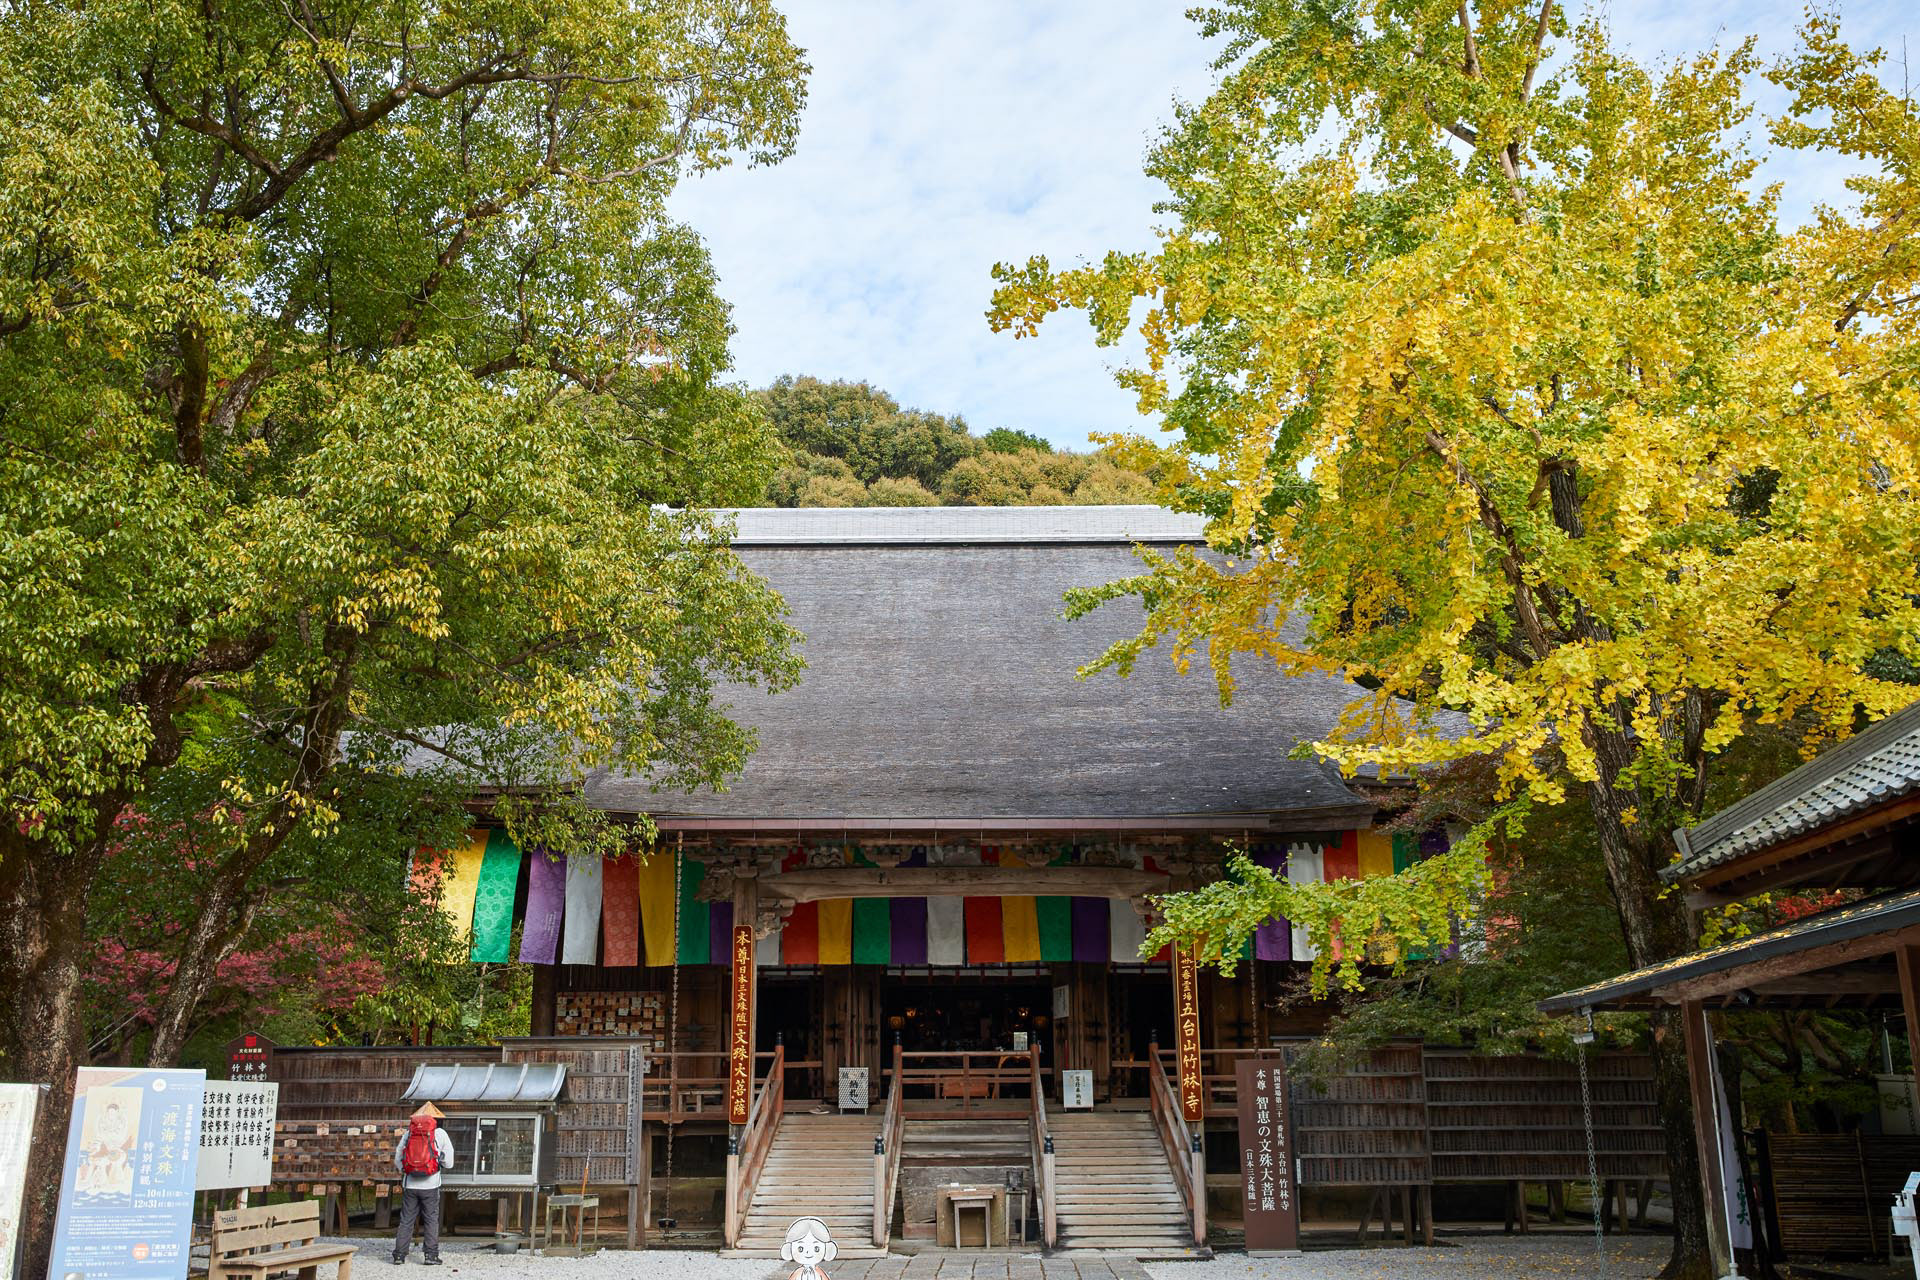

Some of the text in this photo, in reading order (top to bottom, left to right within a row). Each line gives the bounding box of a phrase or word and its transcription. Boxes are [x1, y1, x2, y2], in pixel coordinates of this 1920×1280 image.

[207, 1091, 215, 1147] 交通安全
[248, 1093, 257, 1146] 受験合格
[256, 1094, 264, 1146] 家内安全
[1256, 1069, 1276, 1211] 本尊 智恵の文殊大菩薩
[1278, 1151, 1287, 1175] 五台山
[1279, 1178, 1290, 1211] 竹林寺
